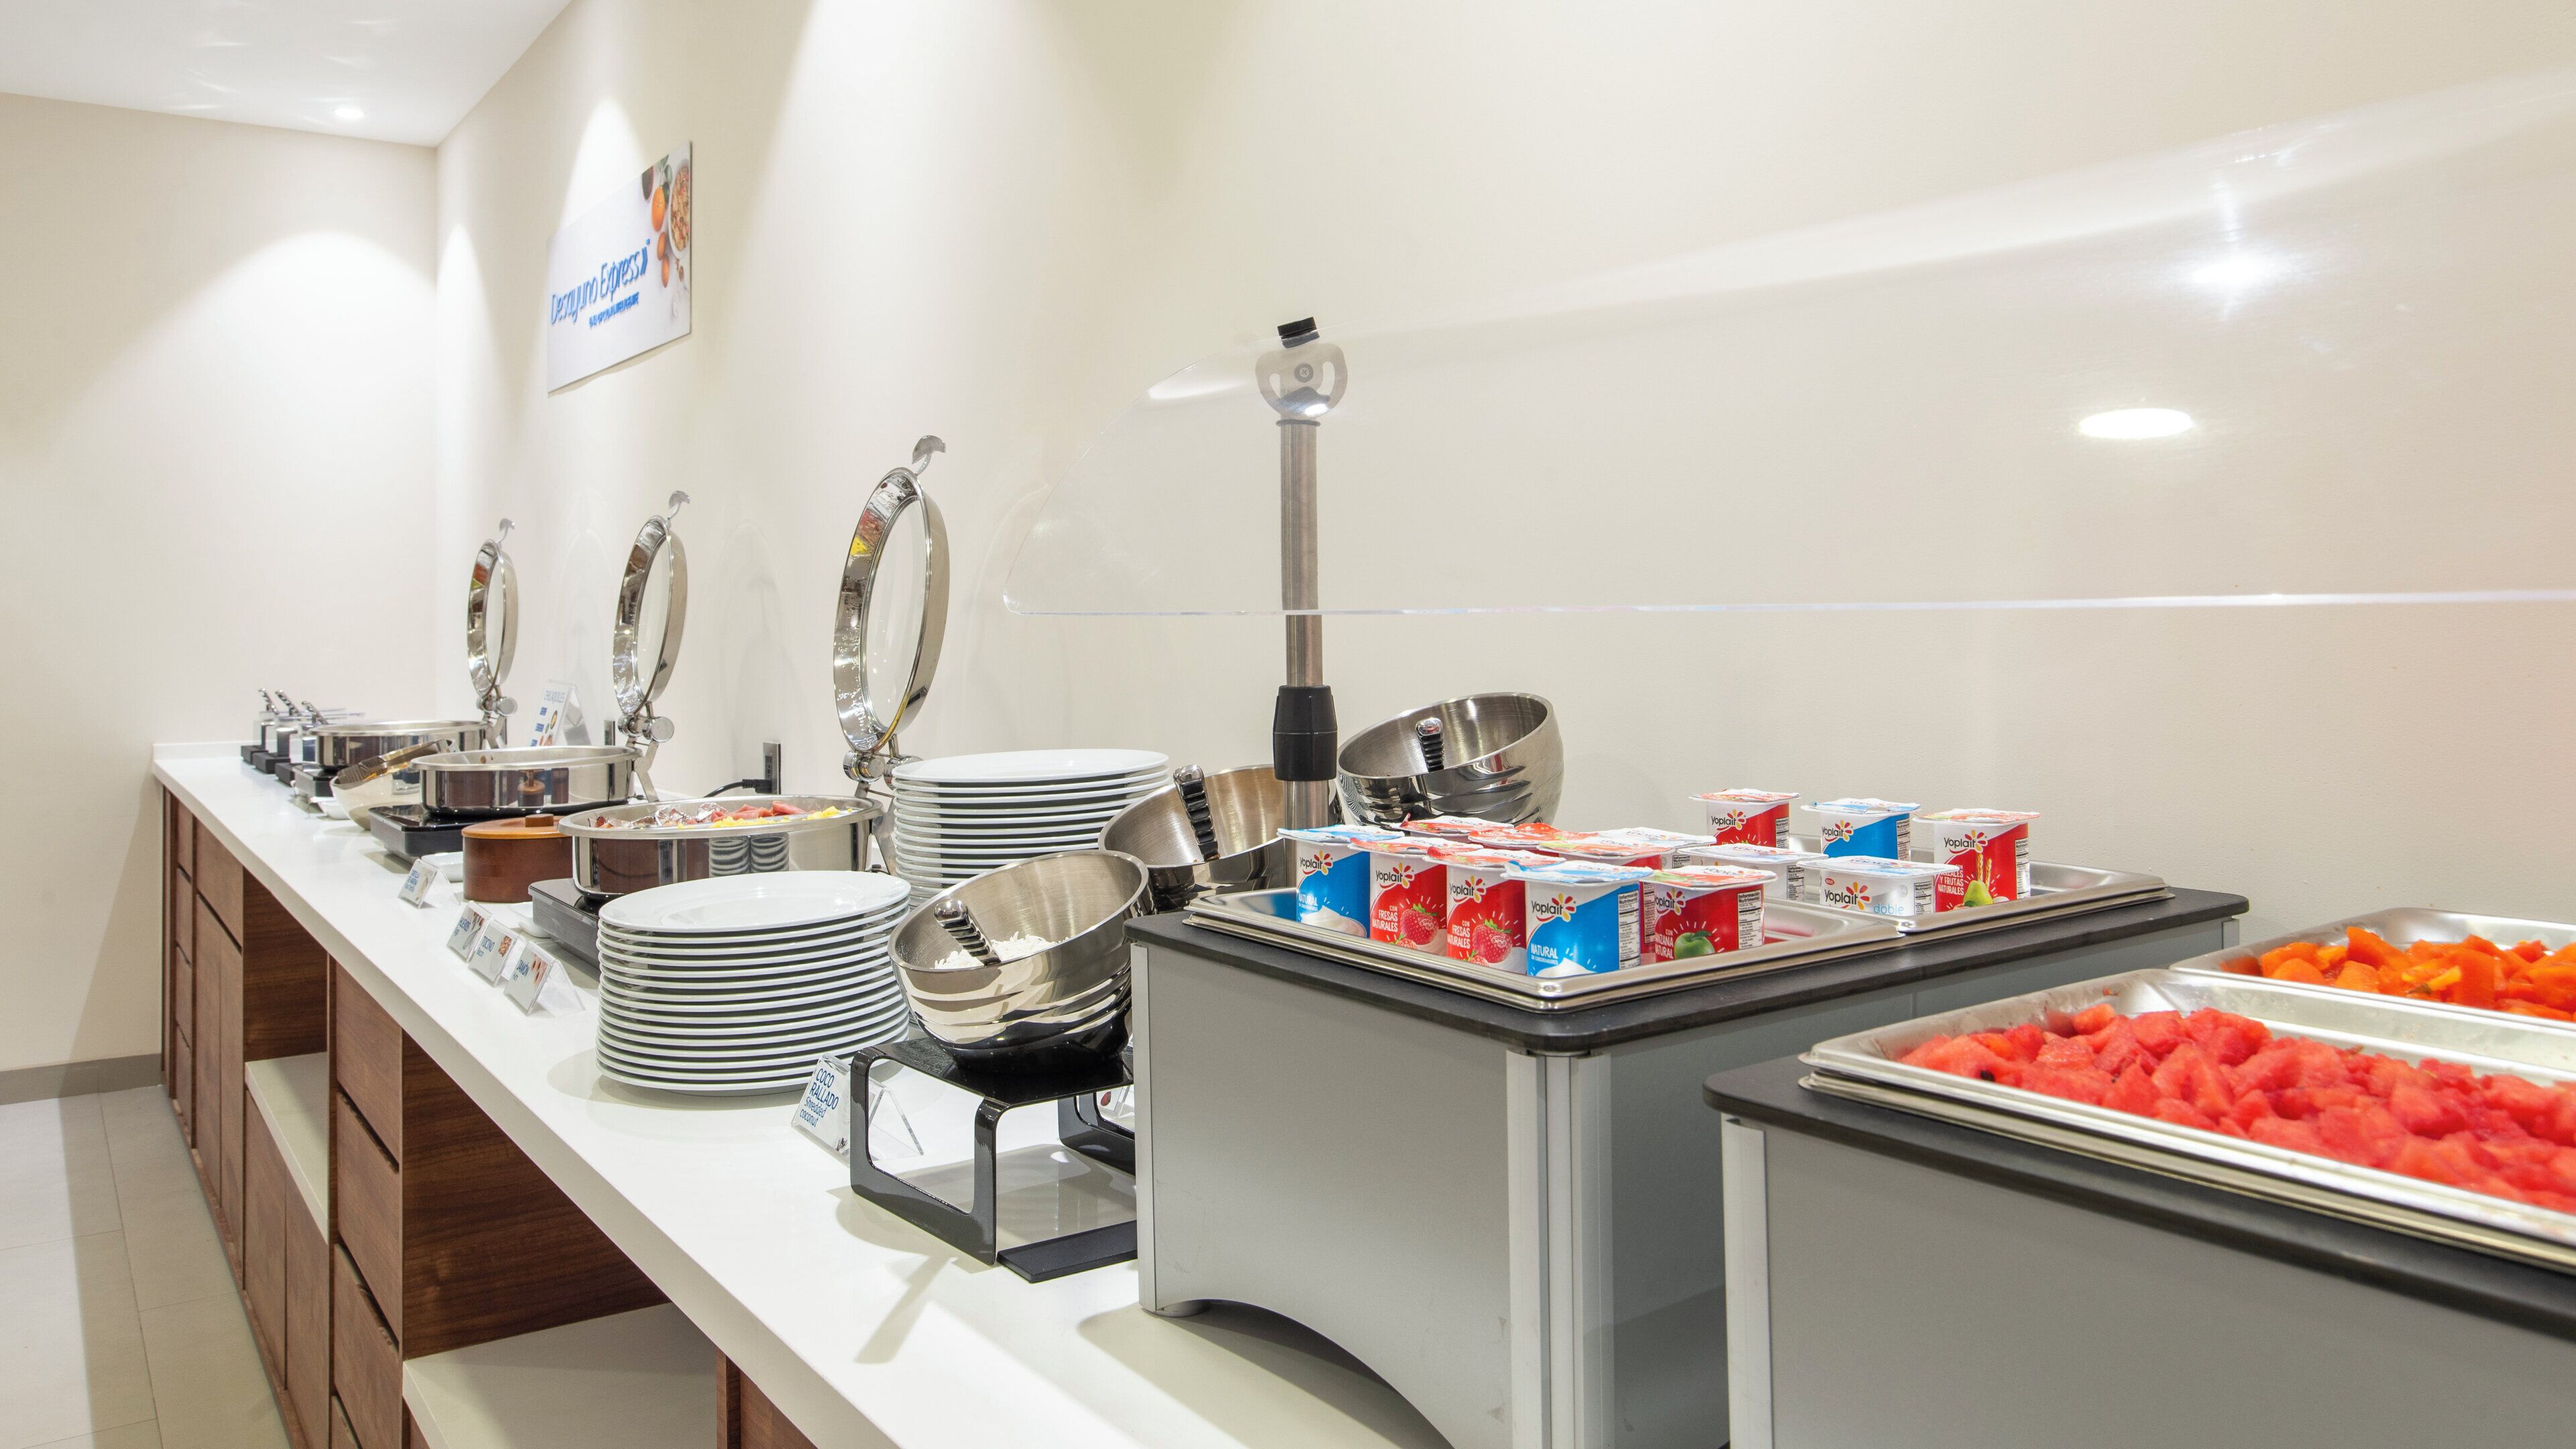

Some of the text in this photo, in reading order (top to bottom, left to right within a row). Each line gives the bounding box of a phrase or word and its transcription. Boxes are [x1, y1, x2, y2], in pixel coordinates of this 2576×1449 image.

[551, 276, 598, 325] Desayuno
[600, 251, 640, 302] Express
[1711, 816, 1736, 826] Yoplait
[1821, 826, 1844, 837] Yoplait
[1944, 837, 1976, 849] Yoplait
[1299, 856, 1323, 869] Yoplait
[1376, 869, 1403, 883] Yoplait
[1944, 876, 1964, 887] FRUTAS
[1449, 882, 1474, 896] Yoplait
[1938, 883, 1964, 896] NATURALES
[1298, 893, 1318, 906] NATURAL
[1824, 889, 1858, 905] Yoplait
[1531, 900, 1563, 915] Yoplait
[1874, 903, 1904, 914] doble
[1379, 910, 1398, 922] FRESAS
[1372, 918, 1398, 932] NATURALES
[1452, 924, 1470, 938] FRESAS
[1531, 943, 1558, 959] NATURAL
[816, 1068, 835, 1088] COCO
[809, 1081, 839, 1110] RALLADO
[804, 1096, 828, 1118] Shredded
[799, 1109, 819, 1128] coconut
